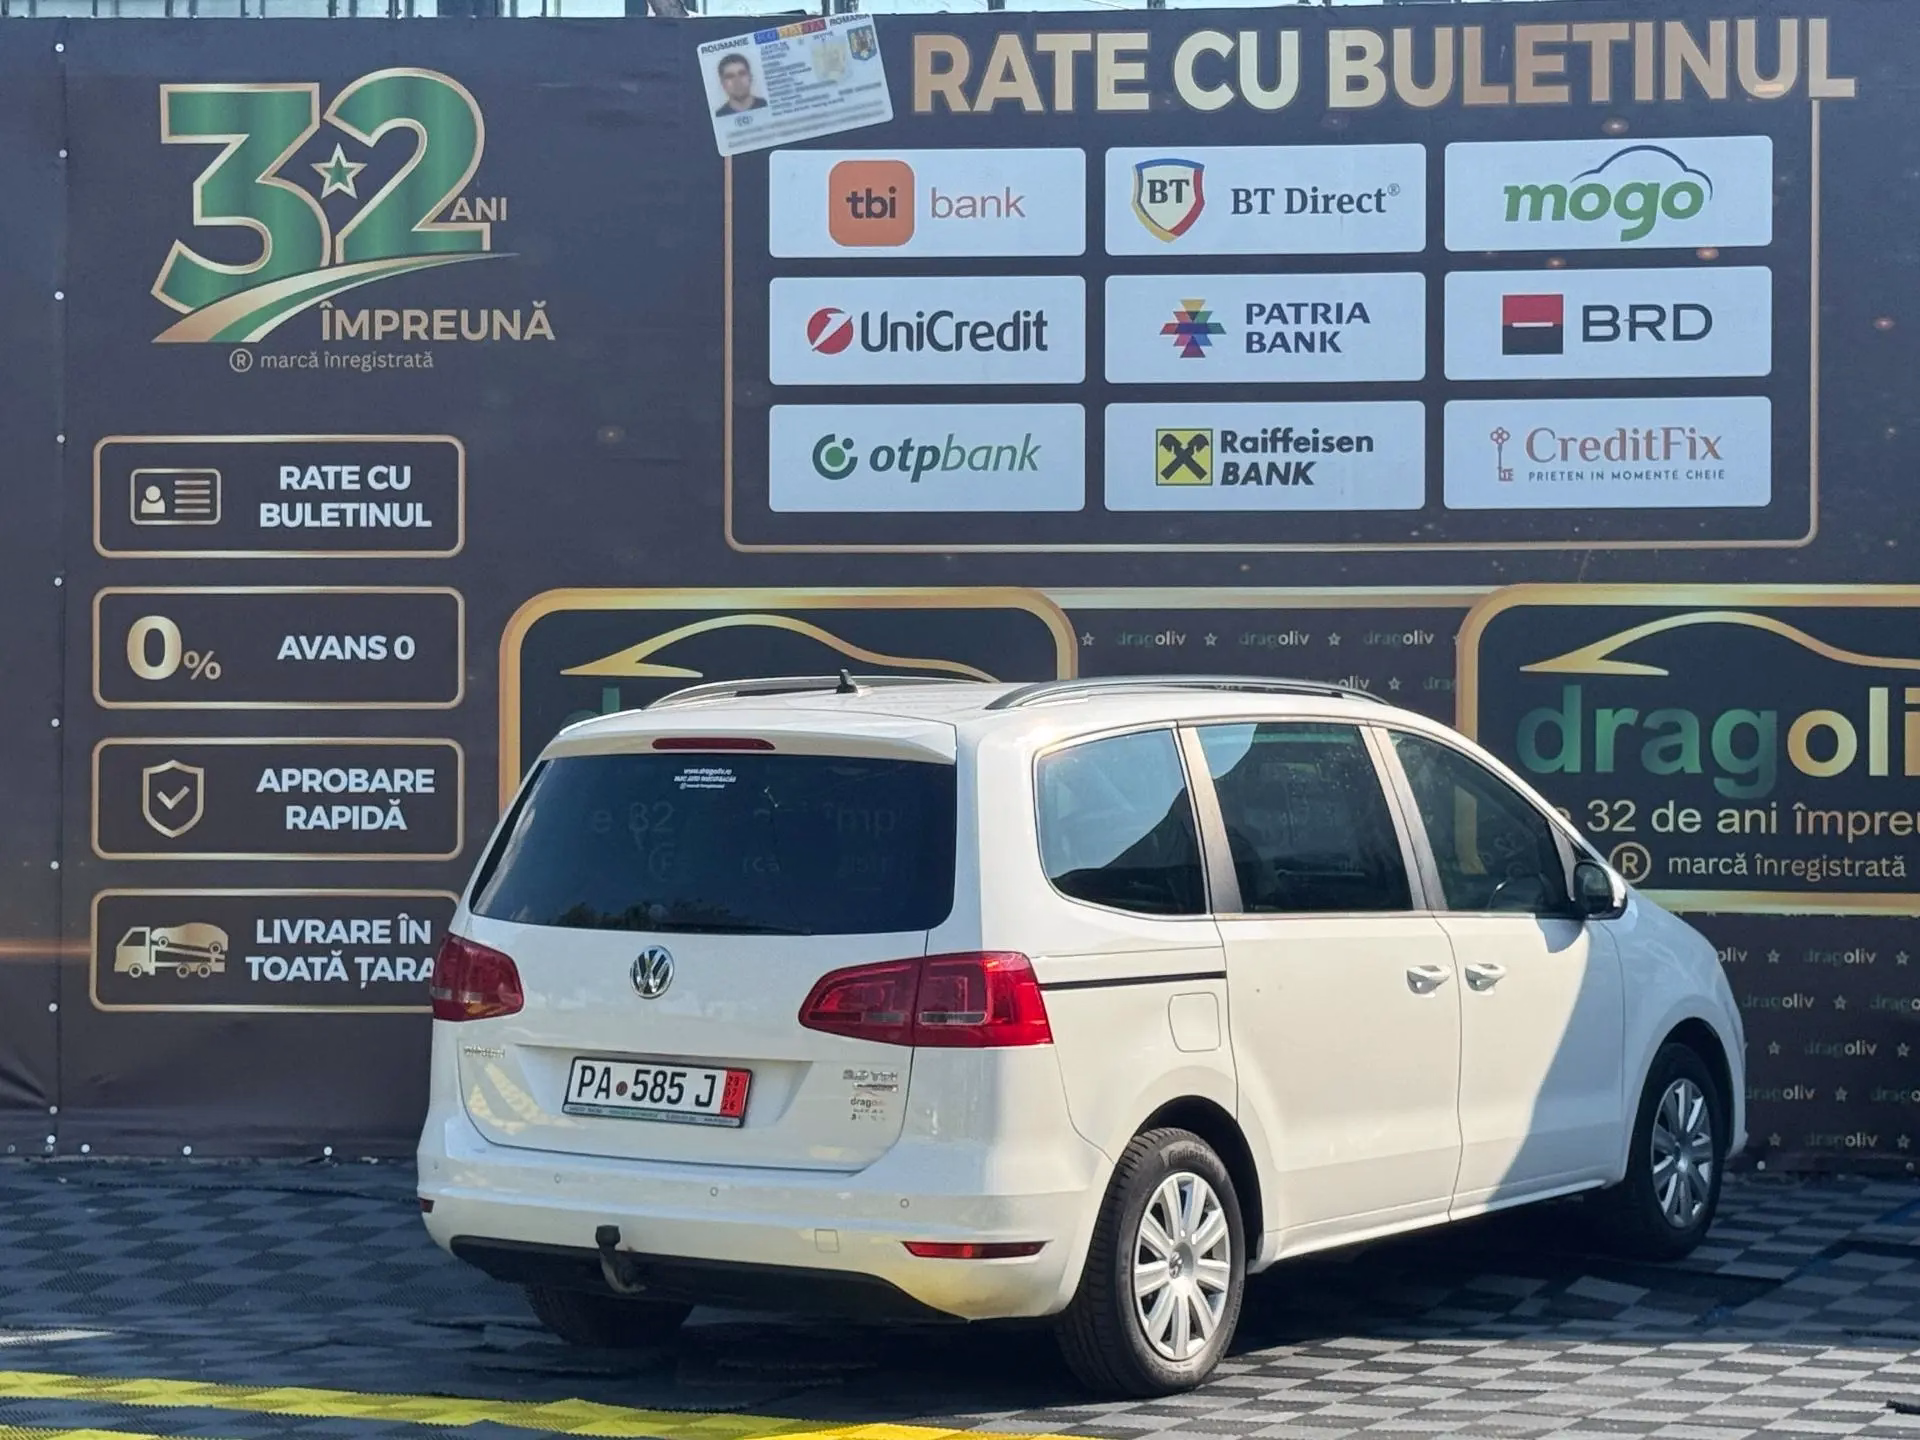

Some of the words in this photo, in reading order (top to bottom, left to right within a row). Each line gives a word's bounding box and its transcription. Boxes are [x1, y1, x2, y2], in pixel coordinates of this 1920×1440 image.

[911, 30, 1150, 113] RATE
[1173, 29, 1300, 111] CU
[1327, 18, 1857, 110] BULETINUL
[151, 67, 490, 314] 32
[846, 186, 897, 219] tbi
[931, 187, 1026, 219] bank
[1148, 179, 1190, 204] BT
[1231, 188, 1275, 215] BT
[450, 197, 508, 222] ANI
[1504, 180, 1705, 242] mogo
[320, 300, 556, 341] ÎMPREUNĂ
[1246, 302, 1371, 325] PATRIA
[1582, 304, 1713, 342] BRD
[861, 310, 1048, 352] UniCredit
[1246, 331, 1342, 354] BANK
[260, 351, 319, 369] marcă
[324, 350, 434, 373] înregistrată
[1221, 427, 1374, 454] Raiffeisen
[1526, 427, 1724, 463] CreditFix
[869, 433, 1042, 484] otpbank
[1220, 461, 1317, 486] BANK
[279, 465, 361, 491] RATE
[367, 465, 411, 491] CU
[1529, 471, 1585, 482] PRIETEN
[1591, 471, 1605, 481] IN
[1612, 469, 1679, 480] MOMENTE
[1686, 468, 1725, 480] CHEIE
[260, 502, 432, 528] BULETINUL
[277, 635, 388, 661] AVANS
[394, 635, 416, 661] 0
[256, 768, 435, 793] APROBARE
[286, 798, 407, 830] RAPIDĂ
[1587, 800, 1637, 832] 32
[1651, 801, 1702, 833] de
[1717, 801, 1777, 834] ani
[1792, 802, 1920, 844] împre
[1668, 852, 1748, 877] marcă
[1755, 852, 1906, 882] înregistrată
[256, 919, 391, 945] LIVRARE
[397, 912, 432, 945] ÎN
[245, 949, 349, 982] TOATĂ
[577, 1065, 612, 1100] PA
[631, 1069, 688, 1105] 585
[694, 1074, 717, 1108] J
